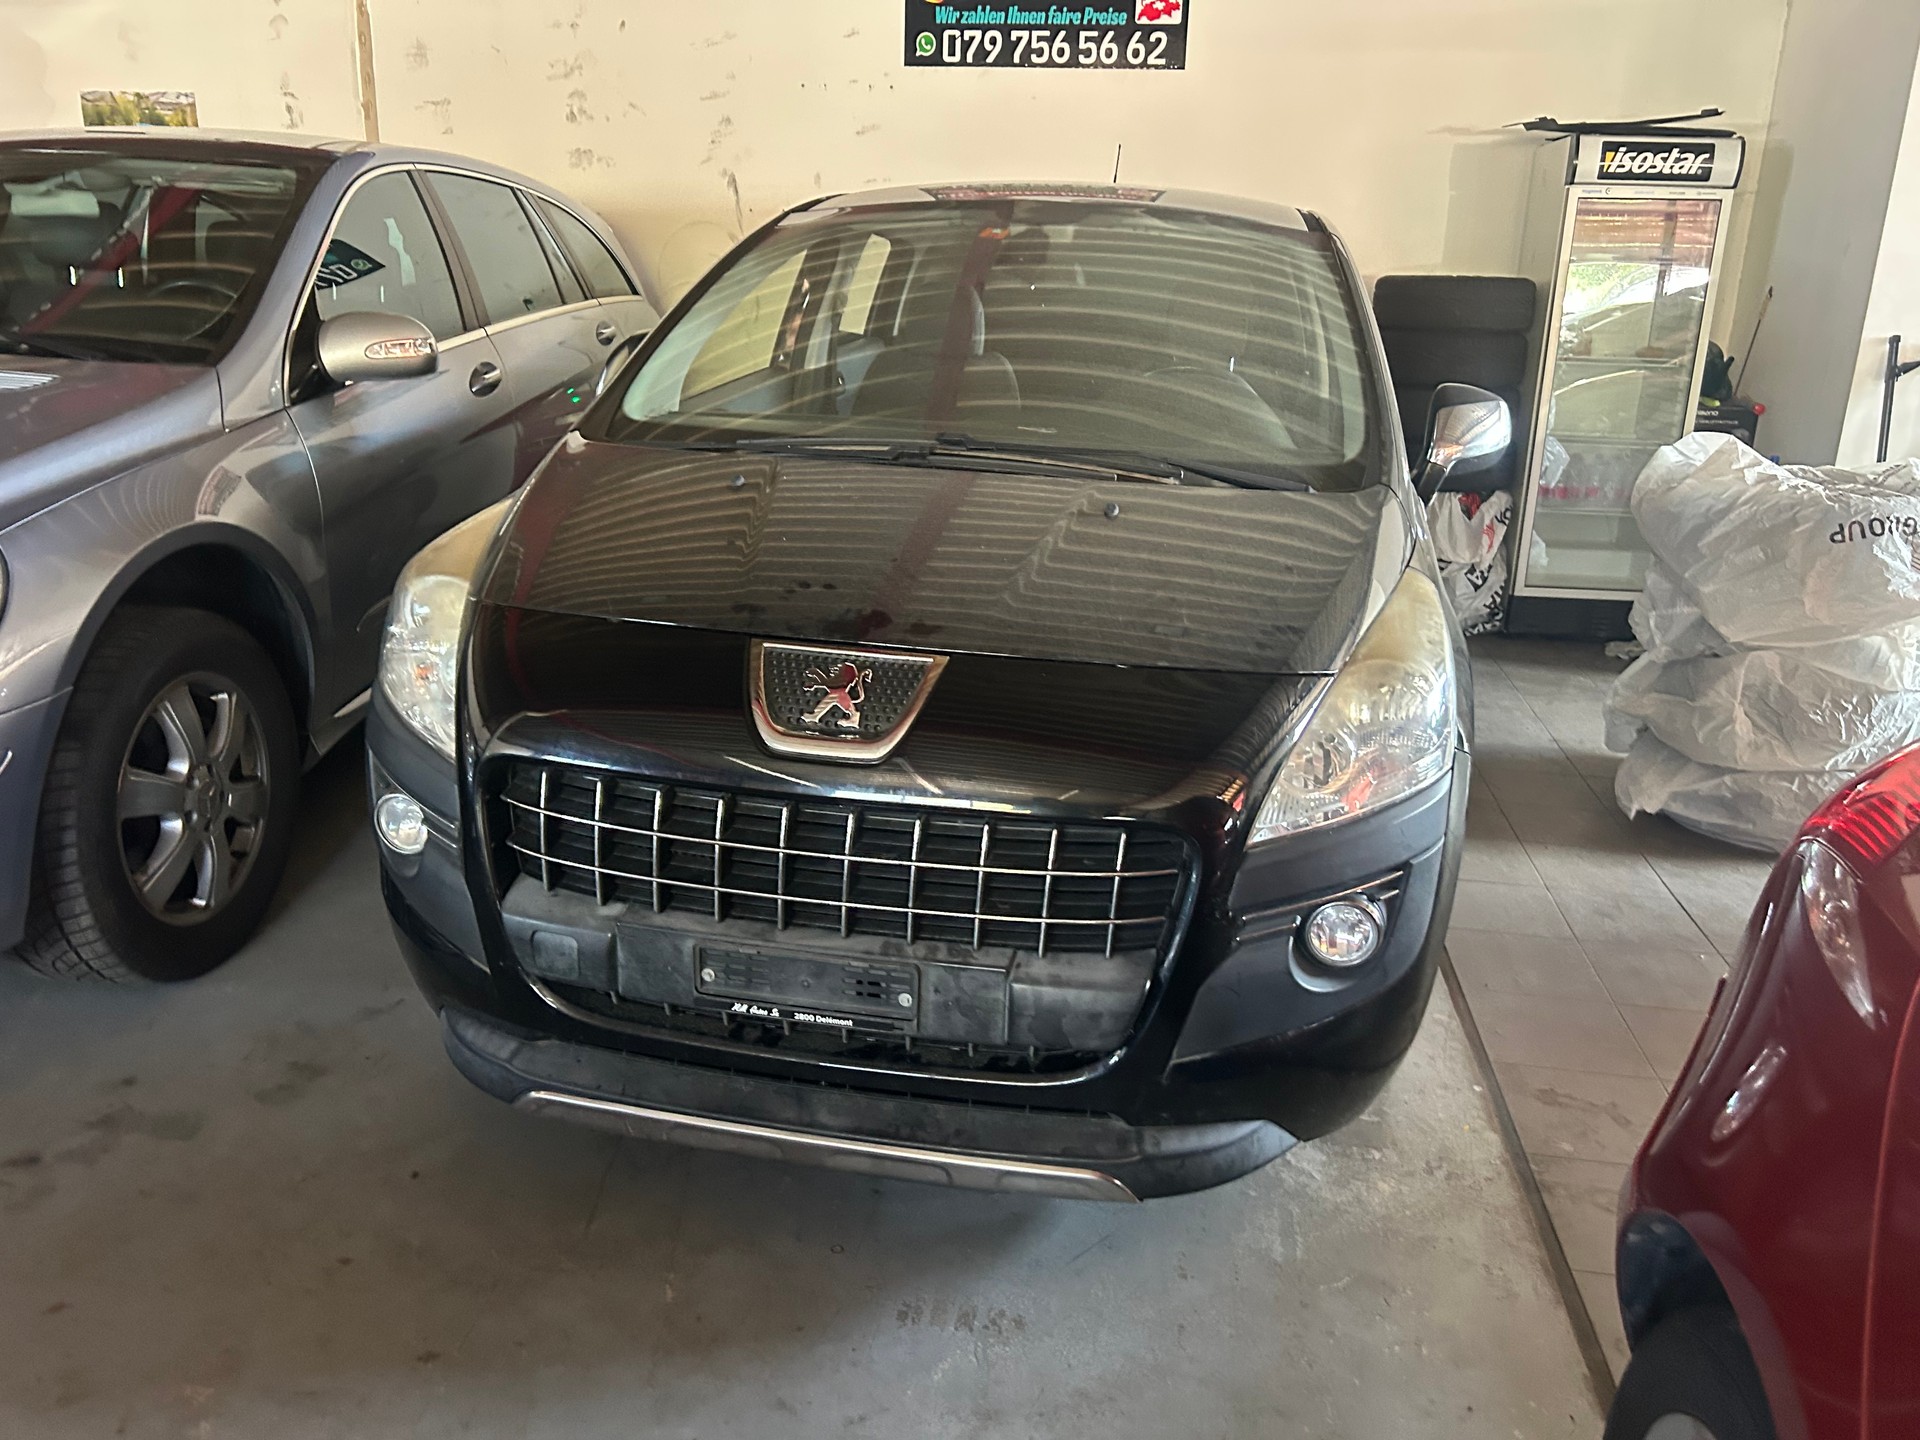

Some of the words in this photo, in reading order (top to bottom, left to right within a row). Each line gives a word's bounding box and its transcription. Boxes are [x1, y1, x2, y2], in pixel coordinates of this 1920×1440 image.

[935, 5, 959, 25] Wir
[960, 6, 1005, 25] zahlen
[1007, 6, 1045, 25] Ihnen
[1048, 6, 1081, 26] faire
[1084, 7, 1127, 26] Preise
[942, 29, 1003, 64] 079
[1010, 29, 1071, 64] 756
[1078, 30, 1119, 65] 56
[1126, 31, 1169, 65] 62
[1607, 146, 1710, 175] isostar
[1829, 516, 1918, 544] GROUP
